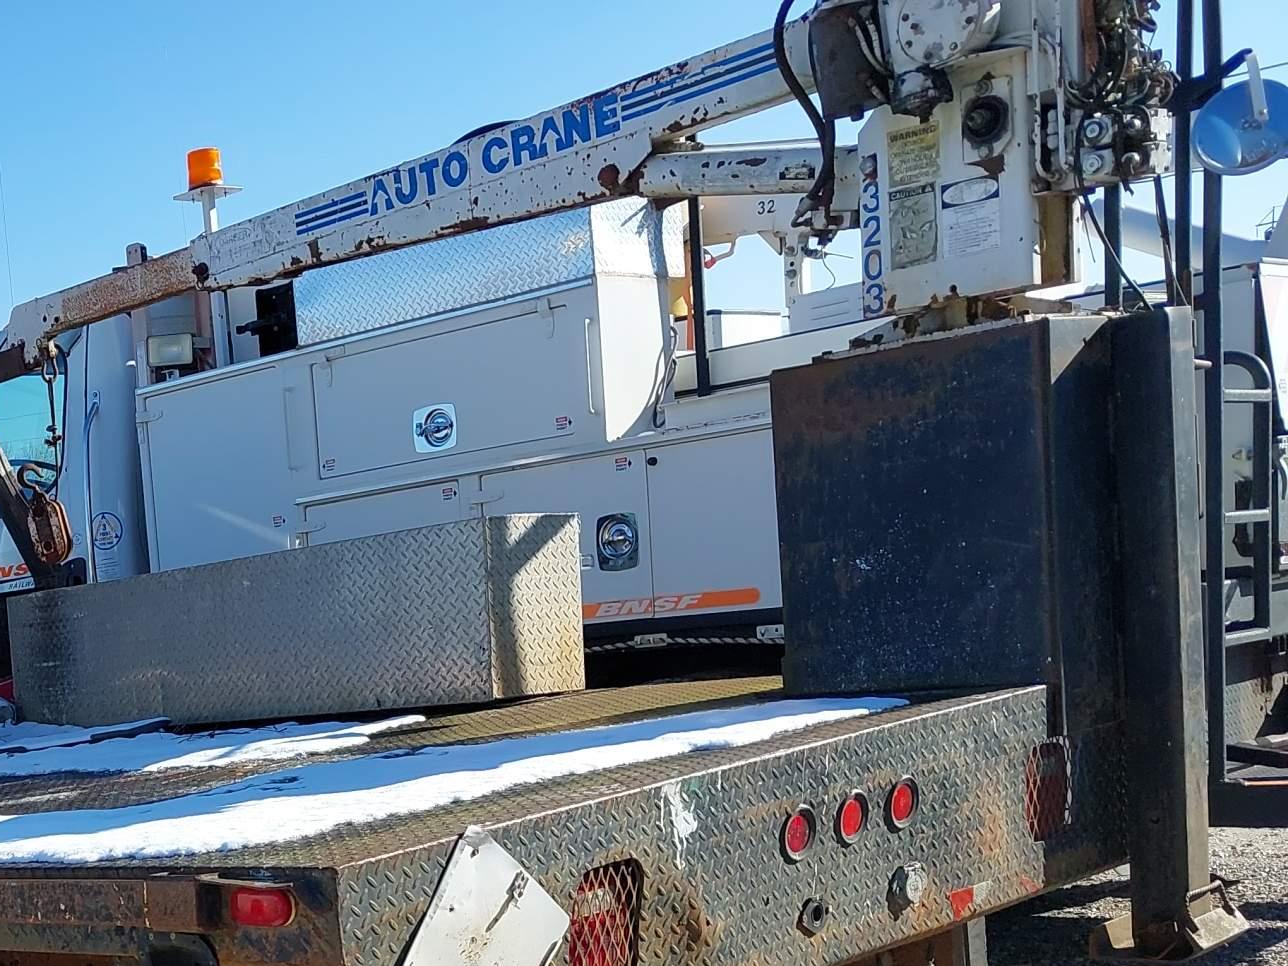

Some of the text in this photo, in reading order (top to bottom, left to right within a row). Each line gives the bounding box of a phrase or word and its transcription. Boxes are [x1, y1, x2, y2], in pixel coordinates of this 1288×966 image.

[889, 125, 937, 144] WARNING
[370, 92, 621, 216] AUTO CRANE
[890, 186, 923, 200] CAUTION
[757, 199, 776, 215] 32
[862, 181, 884, 315] 3203
[595, 594, 703, 617] BNSF
